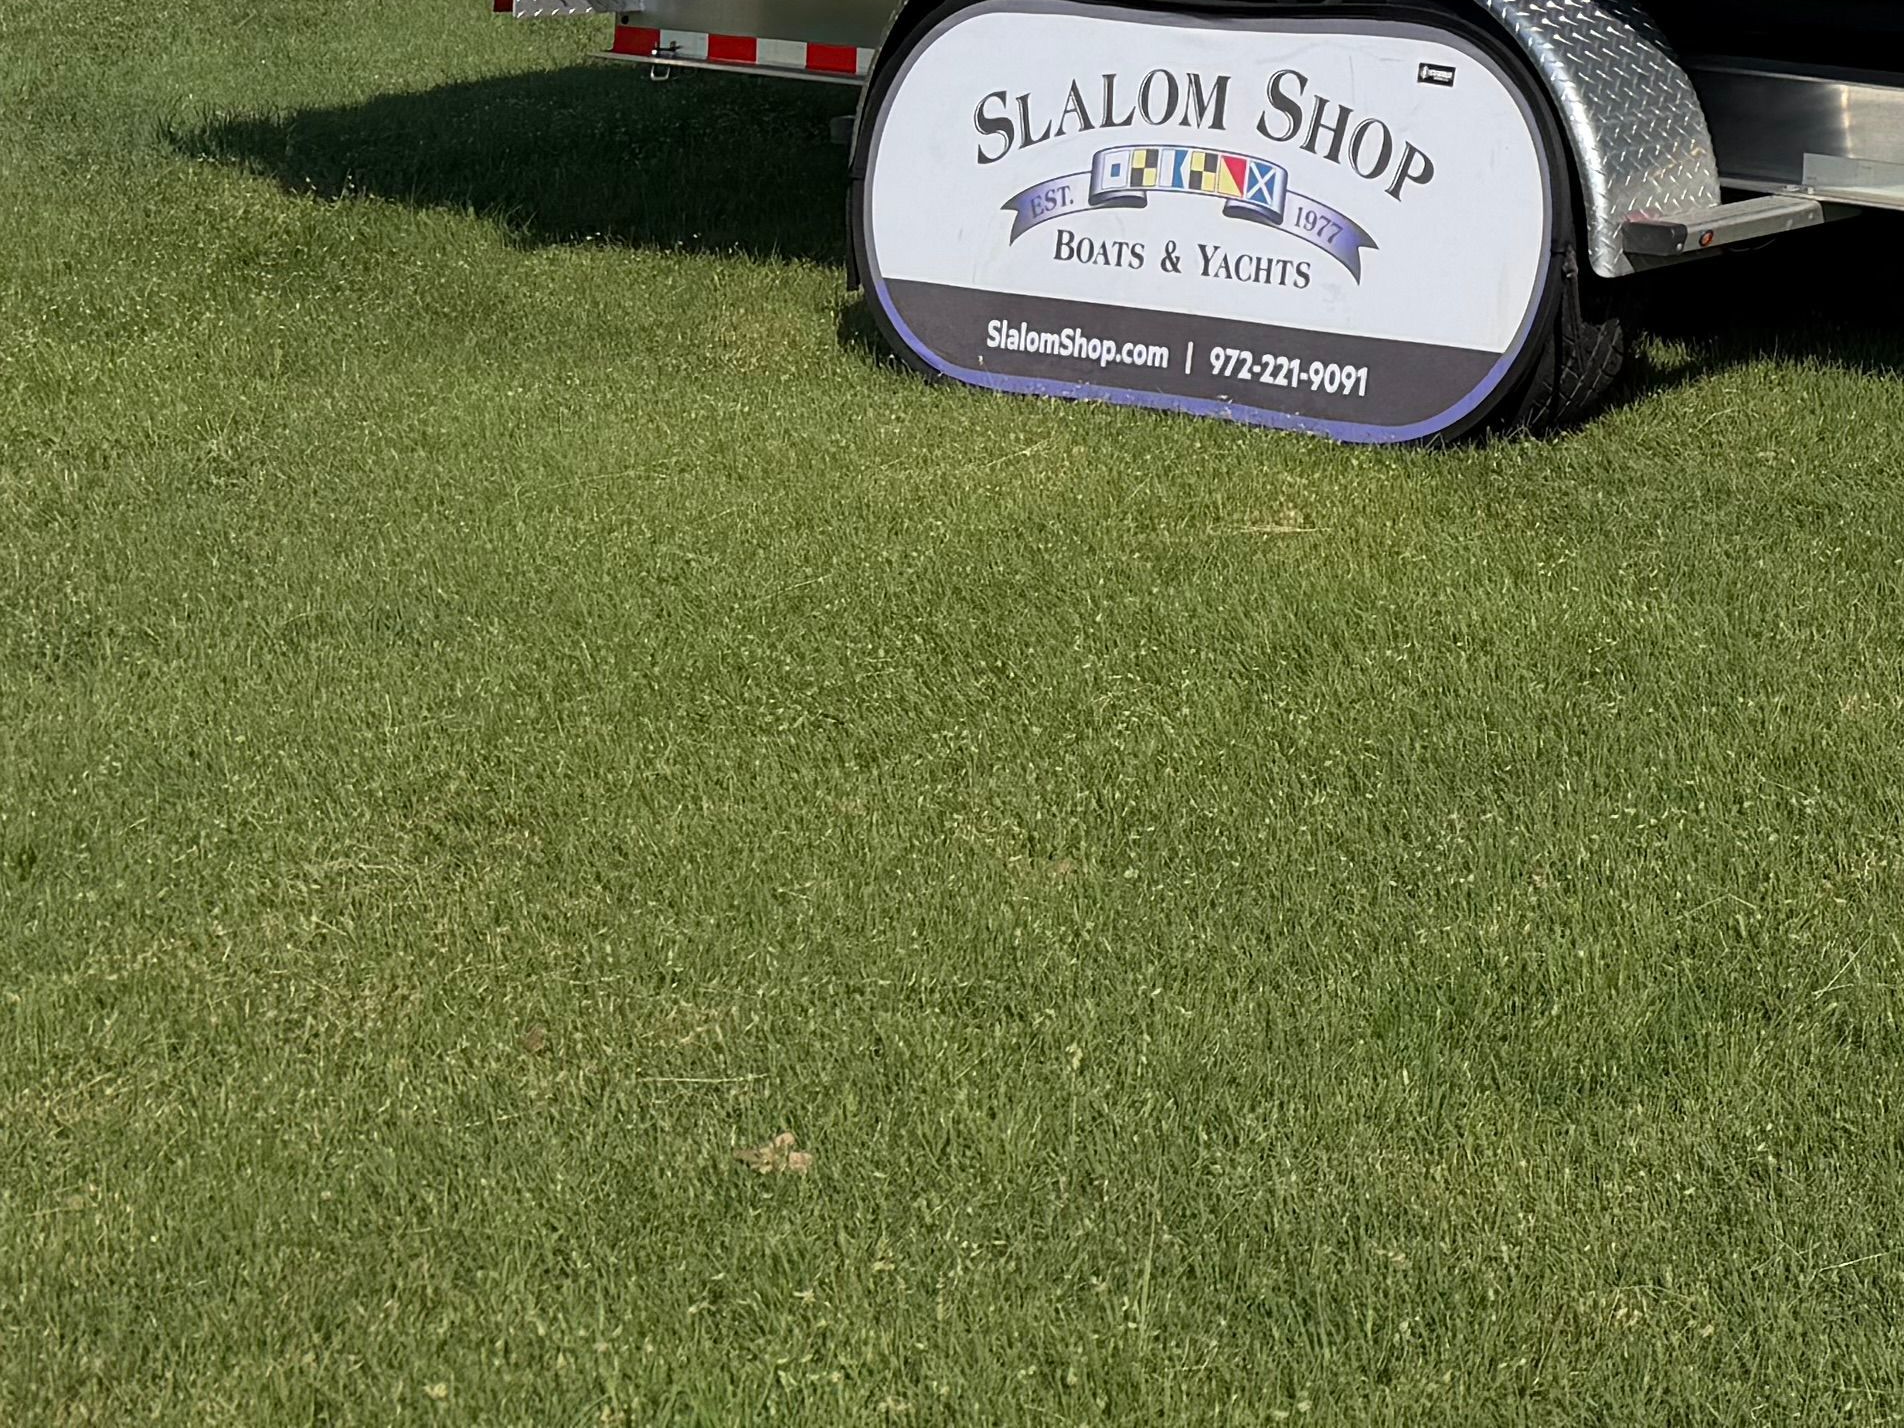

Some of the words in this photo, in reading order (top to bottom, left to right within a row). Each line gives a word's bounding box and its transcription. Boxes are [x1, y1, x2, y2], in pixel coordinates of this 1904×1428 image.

[973, 68, 1231, 165] SLALOM
[1256, 68, 1435, 202] SHOP
[1029, 183, 1074, 221] EST.
[1292, 204, 1345, 245] 1977
[1053, 228, 1145, 271] BOATS
[1160, 240, 1182, 274] &
[1198, 243, 1311, 289] YACHTS
[986, 318, 1169, 370] SlalomShop.com
[1209, 346, 1368, 397] 972-221-9091
